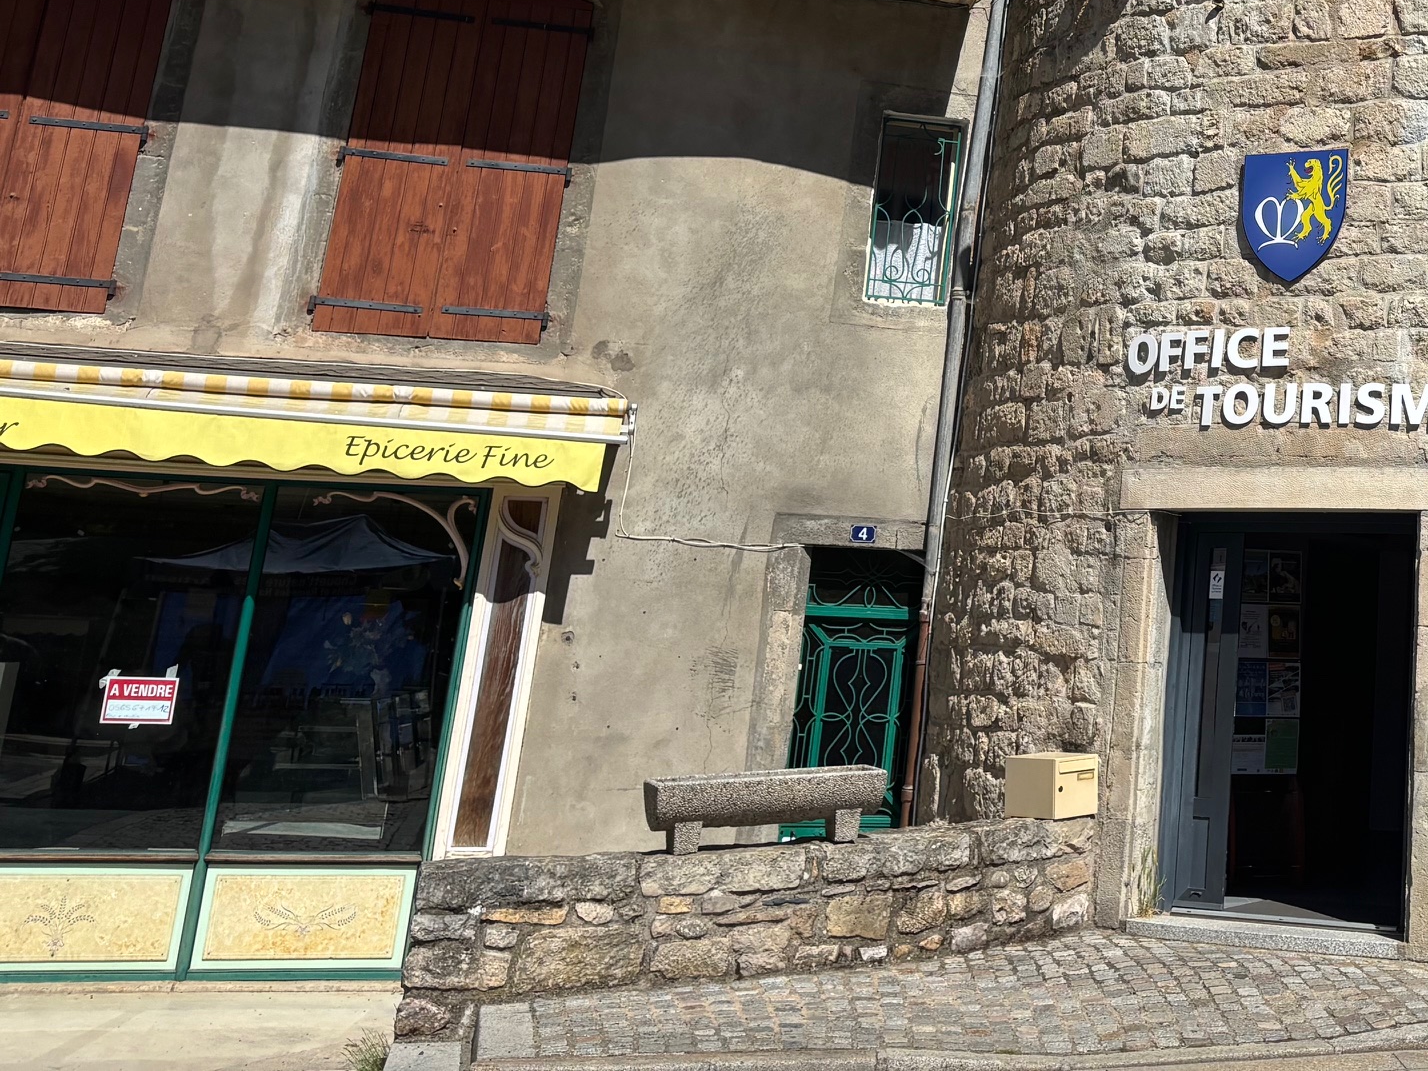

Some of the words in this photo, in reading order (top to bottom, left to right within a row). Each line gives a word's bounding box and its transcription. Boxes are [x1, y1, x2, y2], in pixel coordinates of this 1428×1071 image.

[1127, 326, 1291, 375] OFFICE
[1150, 386, 1186, 412] DE
[345, 435, 477, 465] Epicerie
[480, 445, 555, 469] Fine
[858, 527, 868, 540] 4
[110, 684, 119, 696] A
[123, 684, 173, 697] VENDRE
